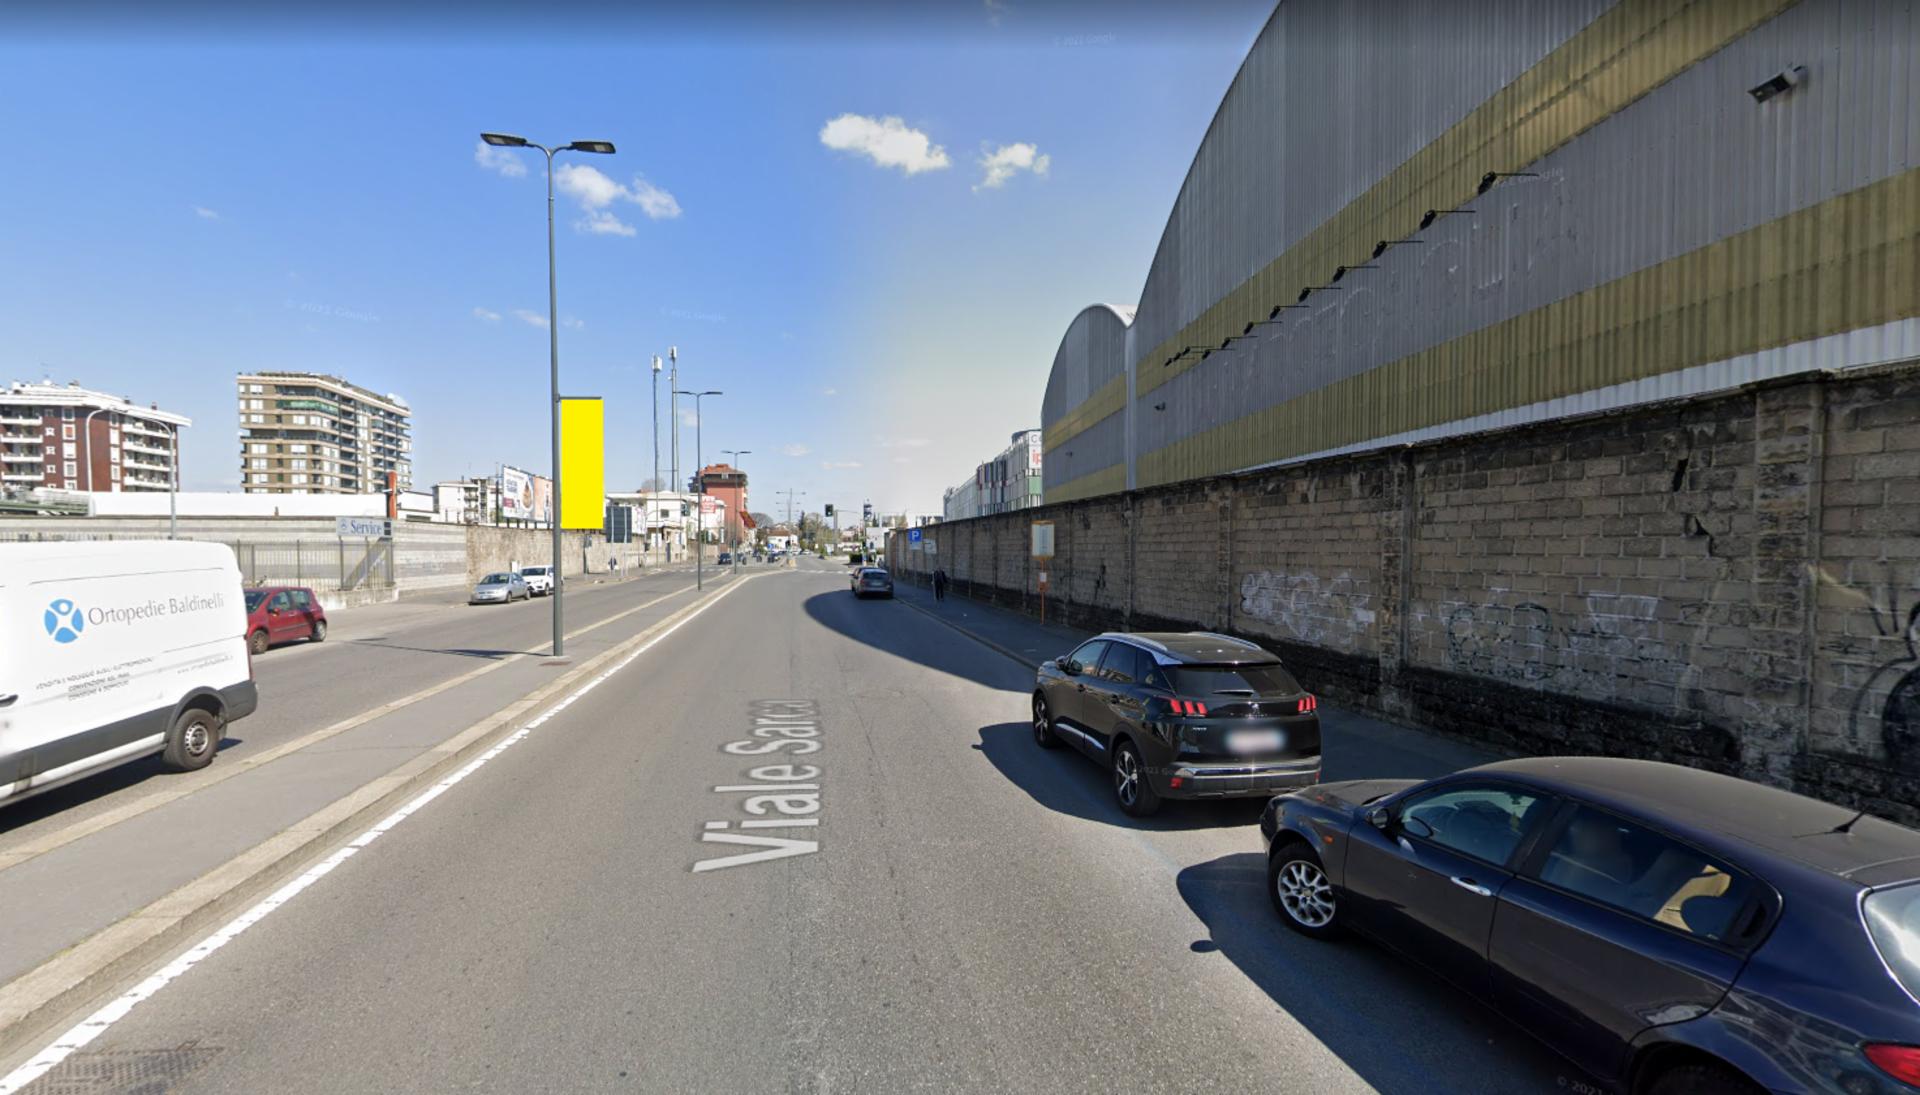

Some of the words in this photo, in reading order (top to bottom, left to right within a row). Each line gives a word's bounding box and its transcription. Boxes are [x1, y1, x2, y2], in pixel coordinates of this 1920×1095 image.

[351, 520, 383, 534] Service
[911, 530, 920, 541] P
[88, 600, 166, 625] Ortopedie
[169, 592, 225, 614] Baldinelli
